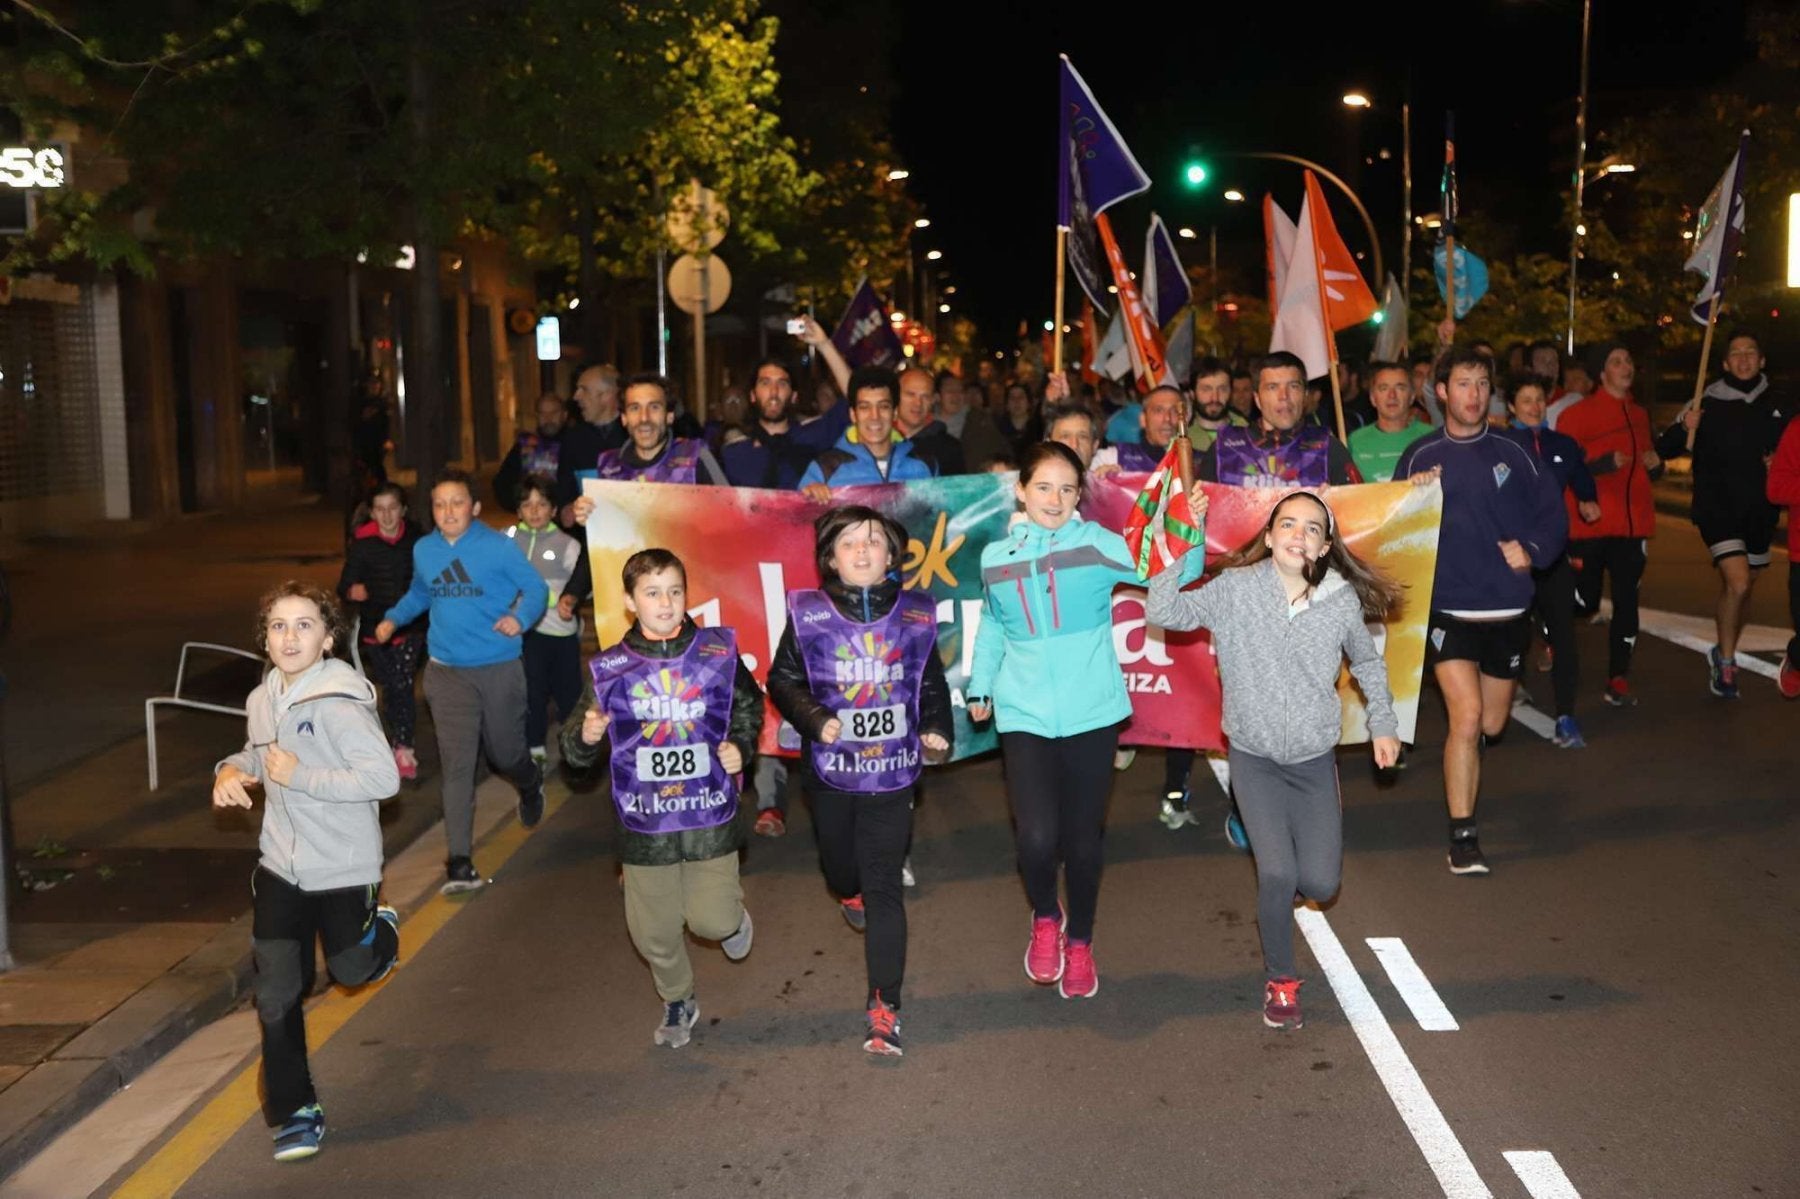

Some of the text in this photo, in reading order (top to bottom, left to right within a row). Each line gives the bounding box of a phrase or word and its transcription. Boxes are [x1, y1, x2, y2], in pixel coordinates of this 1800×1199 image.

[901, 511, 967, 591] ek
[430, 583, 484, 597] adidas
[834, 656, 905, 684] Klika
[631, 694, 707, 721] Klika
[852, 708, 895, 738] 828
[651, 748, 696, 778] 828
